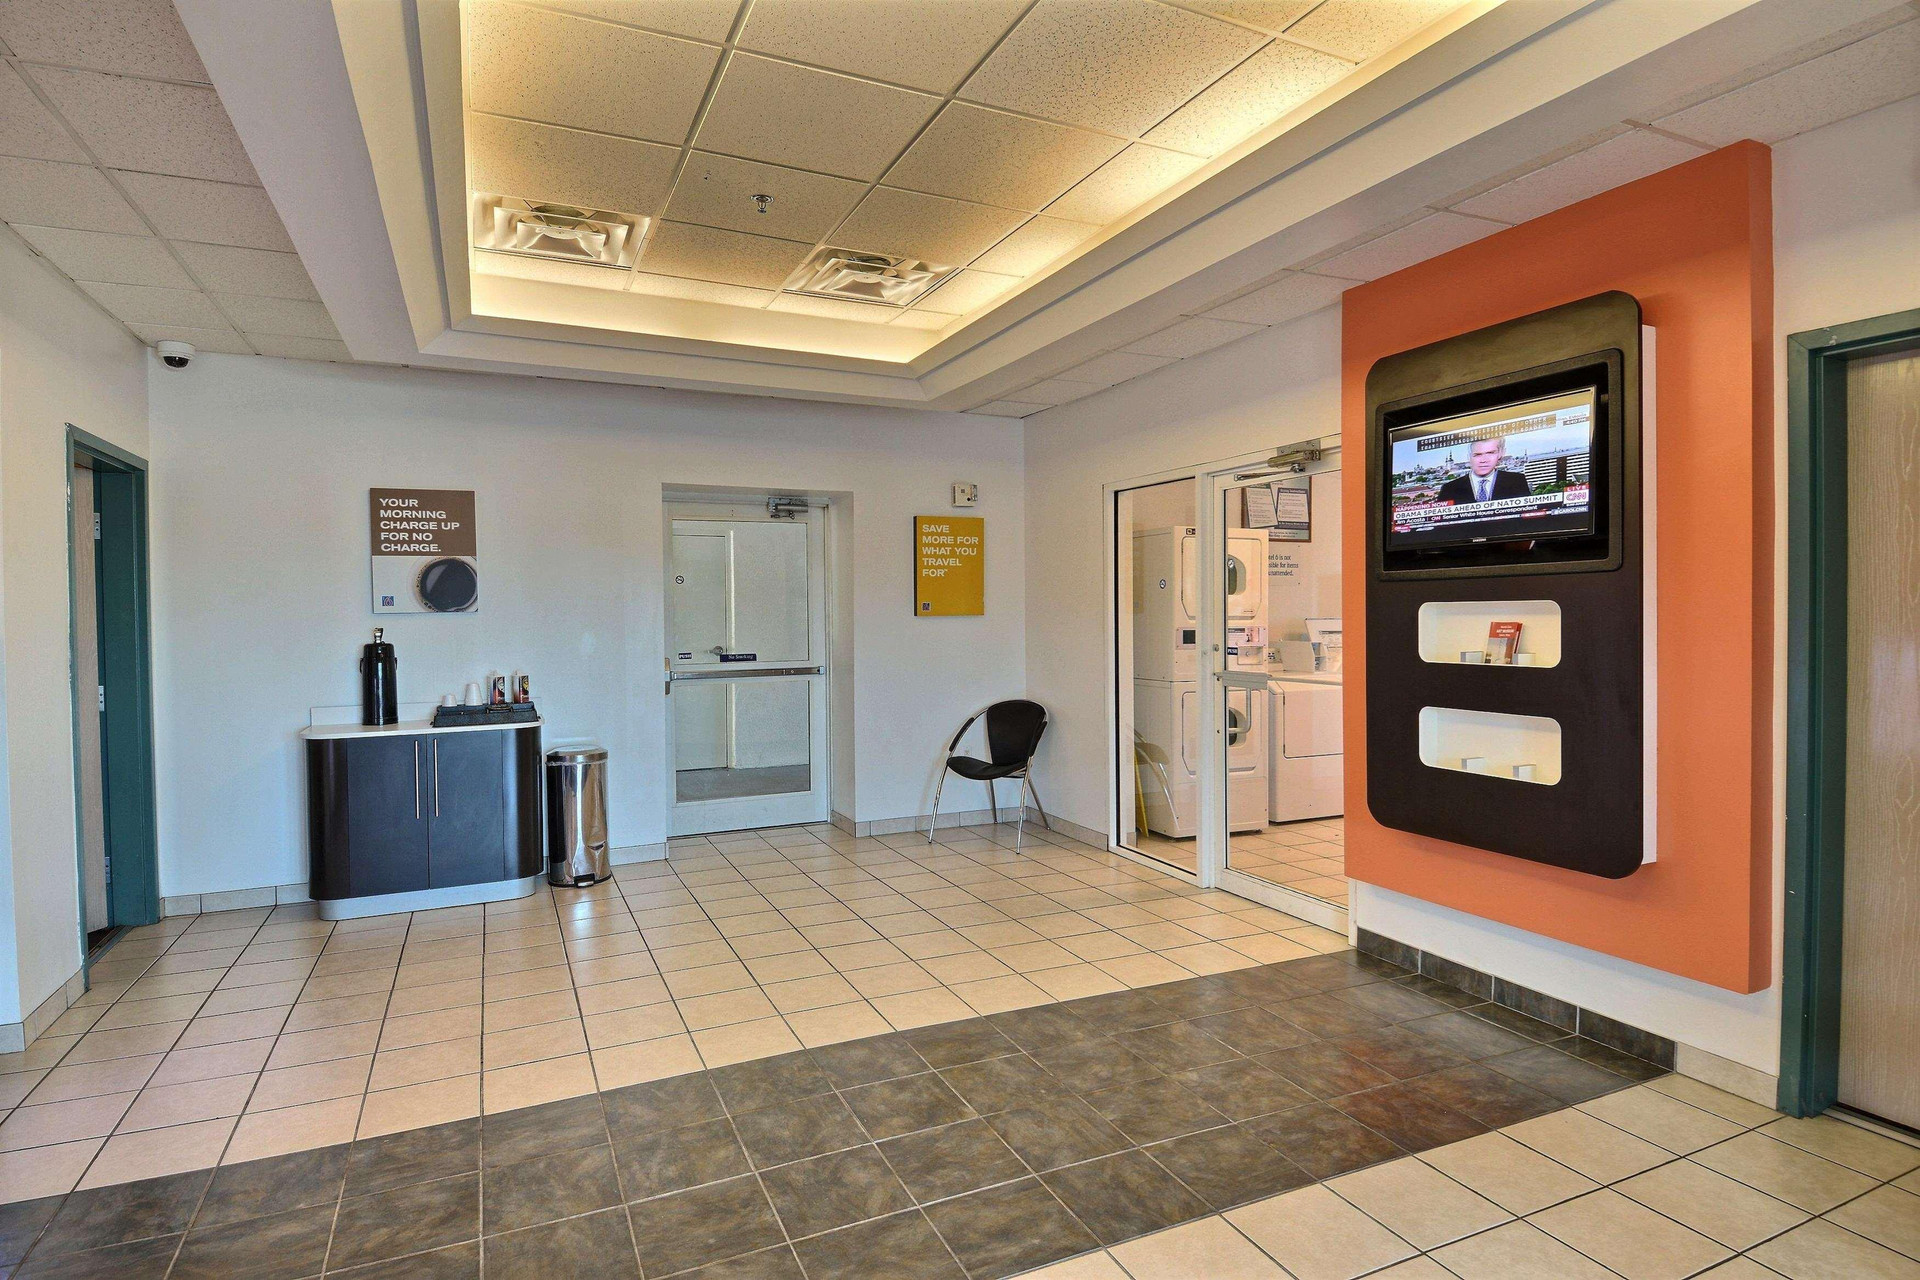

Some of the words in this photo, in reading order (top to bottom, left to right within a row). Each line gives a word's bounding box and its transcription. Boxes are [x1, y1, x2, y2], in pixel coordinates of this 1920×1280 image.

[1566, 492, 1587, 501] CNN
[380, 498, 418, 508] YOUR
[1395, 510, 1422, 519] OBAMA
[1423, 507, 1452, 516] SPEAKS
[1454, 503, 1481, 513] AHEAD
[1497, 499, 1521, 508] NATO
[1524, 494, 1558, 504] SUMMIT
[1395, 503, 1430, 512] HAPPENING
[1494, 504, 1538, 514] Correspondent
[380, 510, 447, 519] MORNING
[380, 521, 438, 530] CHARGE
[441, 522, 460, 530] UP
[922, 524, 949, 533] SAVE
[380, 532, 409, 541] FOR
[412, 532, 433, 541] NO
[922, 536, 955, 544] MORE
[957, 536, 979, 545] FOR
[381, 543, 442, 552] CHARGE.
[922, 547, 952, 555] WHAT
[954, 547, 977, 556] YOU
[922, 557, 962, 566] TRAVEL
